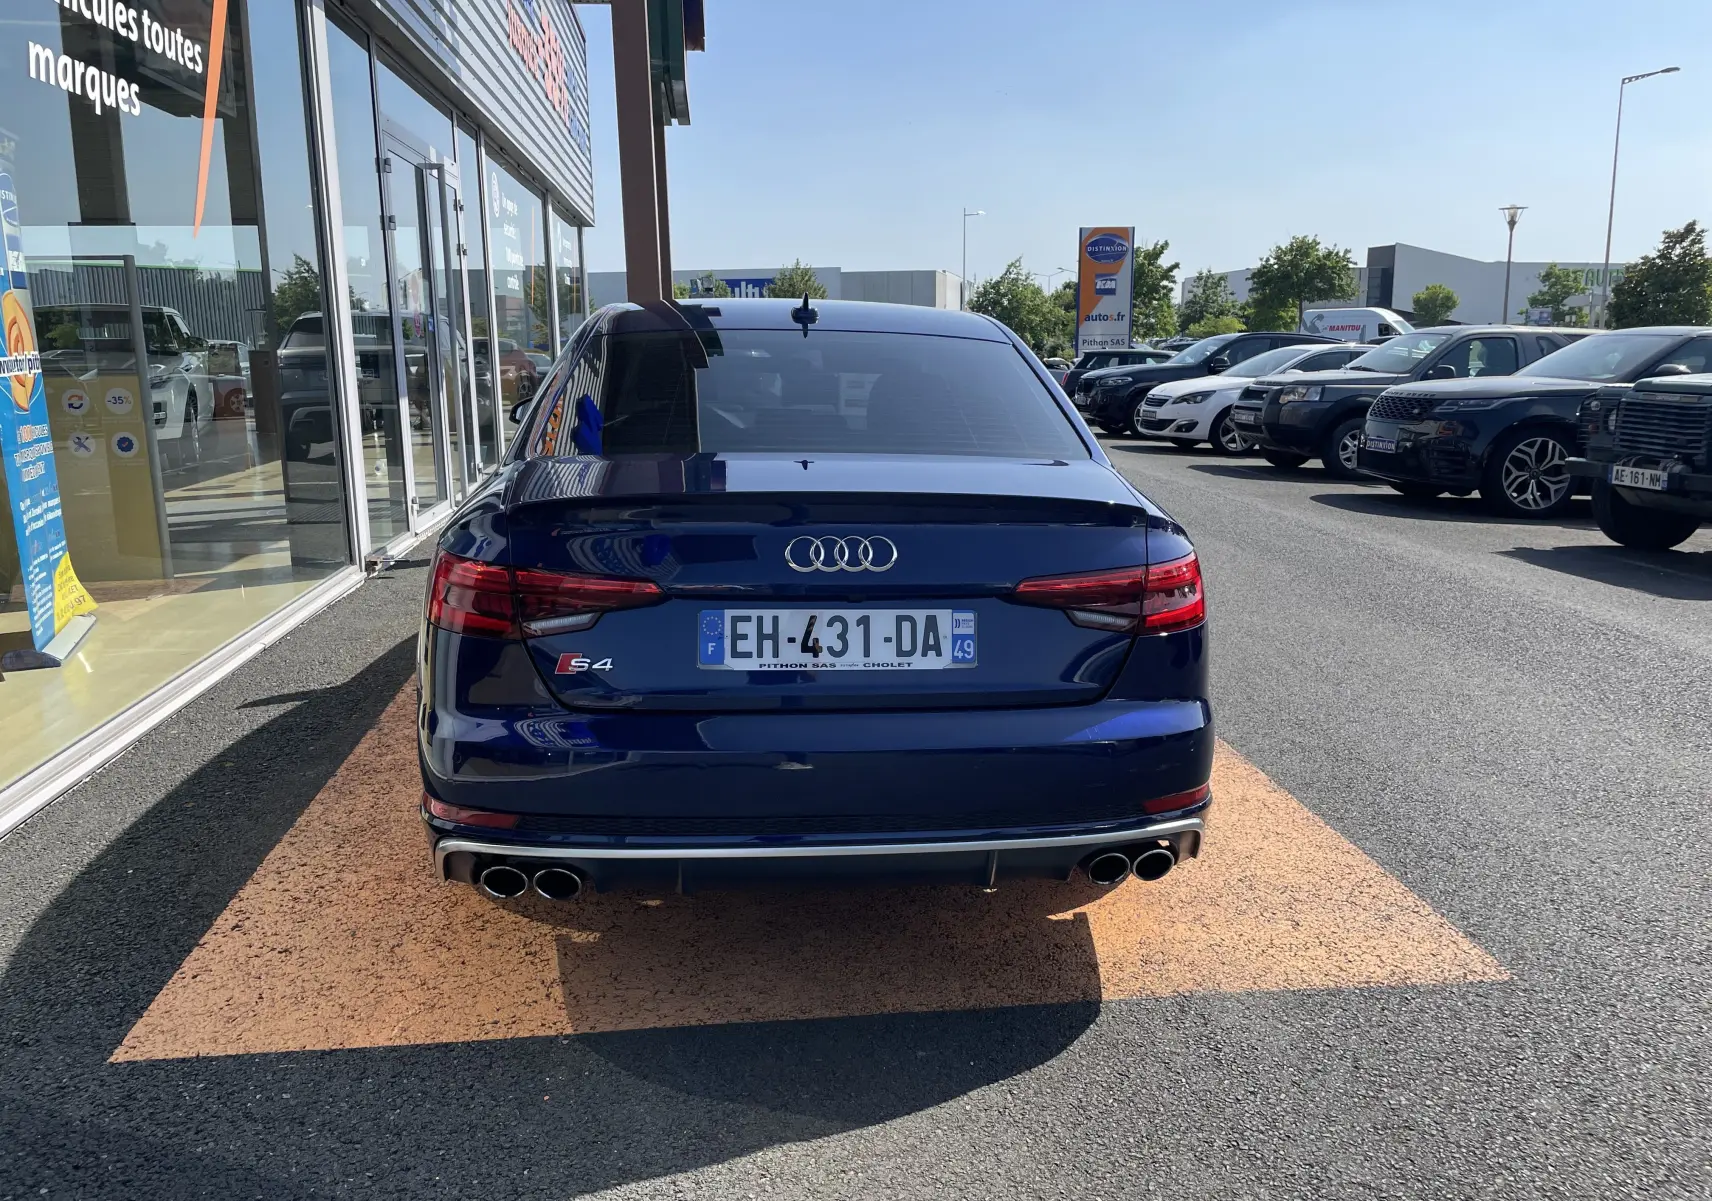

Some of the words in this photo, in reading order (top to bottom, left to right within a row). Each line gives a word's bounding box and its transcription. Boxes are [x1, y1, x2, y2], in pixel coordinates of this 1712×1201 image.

[142, 9, 203, 74] toutes
[28, 41, 141, 116] marques
[1087, 244, 1127, 252] DISTINXION
[1084, 311, 1126, 322] autos.fr
[1328, 324, 1361, 332] MANITOU
[1082, 338, 1109, 347] Pithon
[1110, 338, 1126, 346] SAS
[106, 395, 132, 405] -35%
[730, 614, 943, 659] EH-431-DA
[707, 643, 717, 655] F
[953, 639, 974, 659] 49
[568, 658, 613, 672] S4
